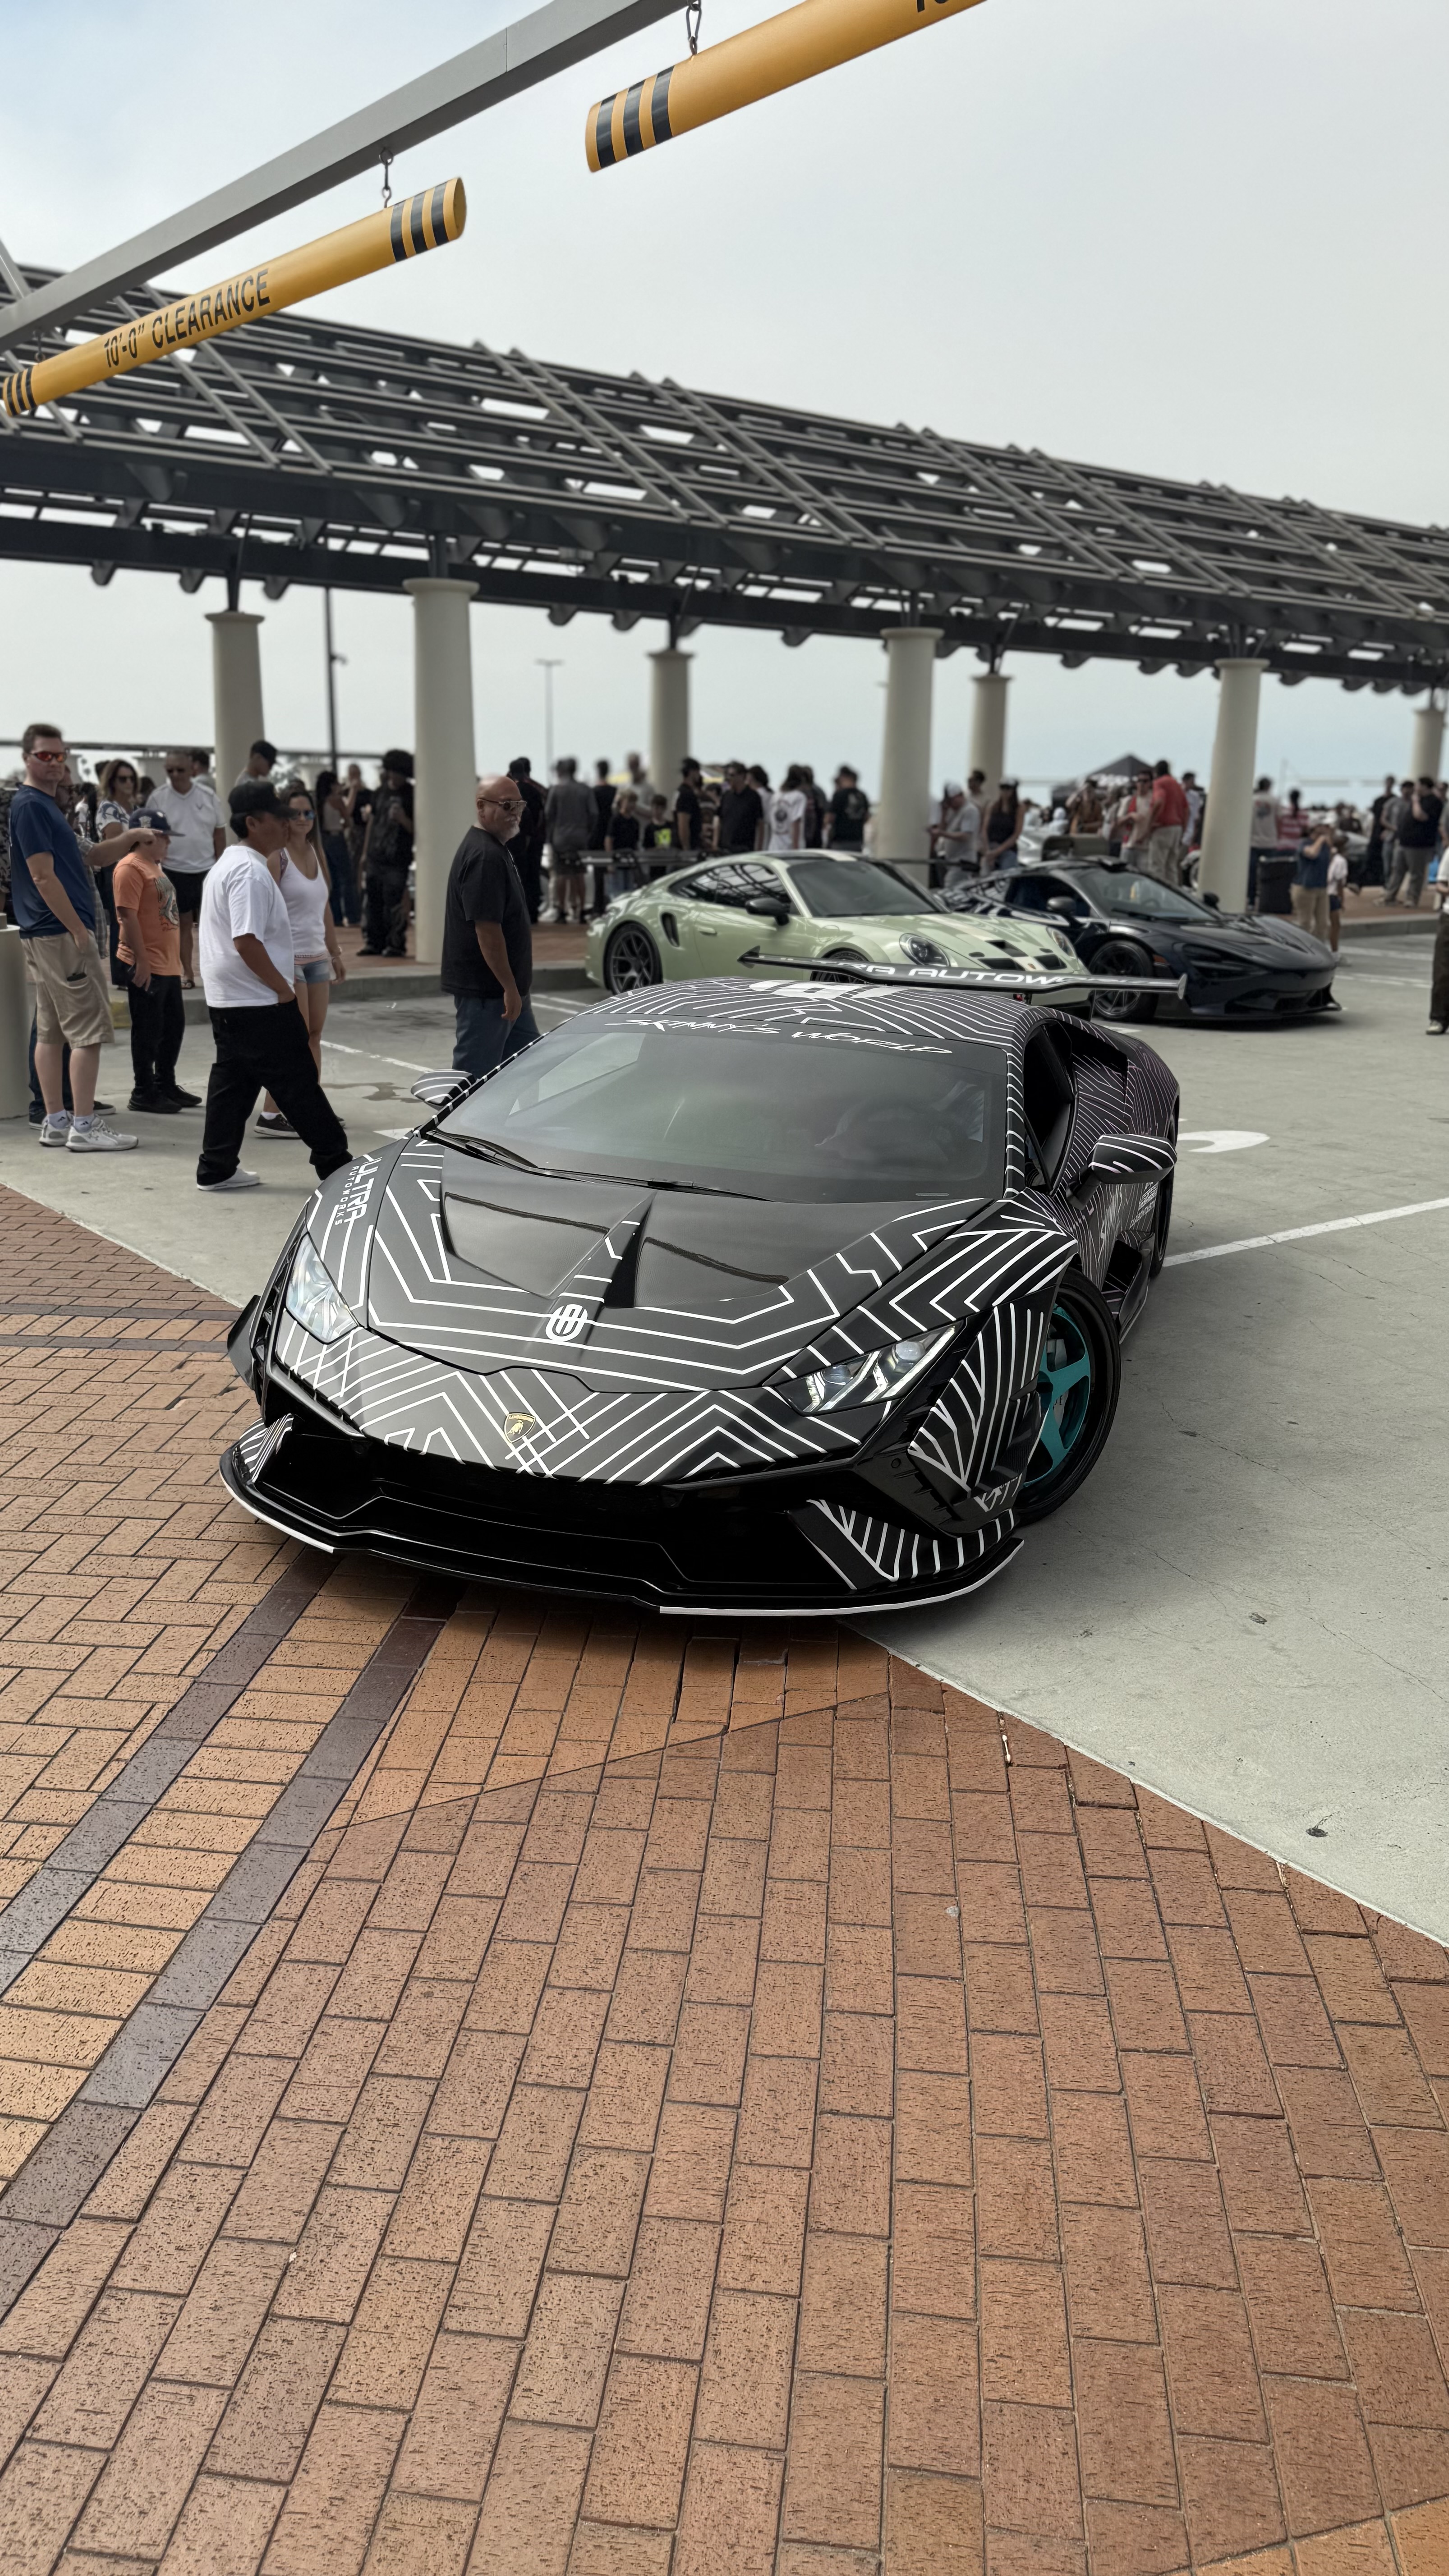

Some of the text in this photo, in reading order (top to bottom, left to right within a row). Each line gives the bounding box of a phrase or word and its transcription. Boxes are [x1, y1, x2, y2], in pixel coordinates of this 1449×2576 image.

[152, 268, 271, 349] CLEARANCE
[604, 1020, 953, 1053] SKINNY'S WORLD
[335, 1165, 359, 1225] AUTOWORKS
[344, 1158, 382, 1223] ULTRA
